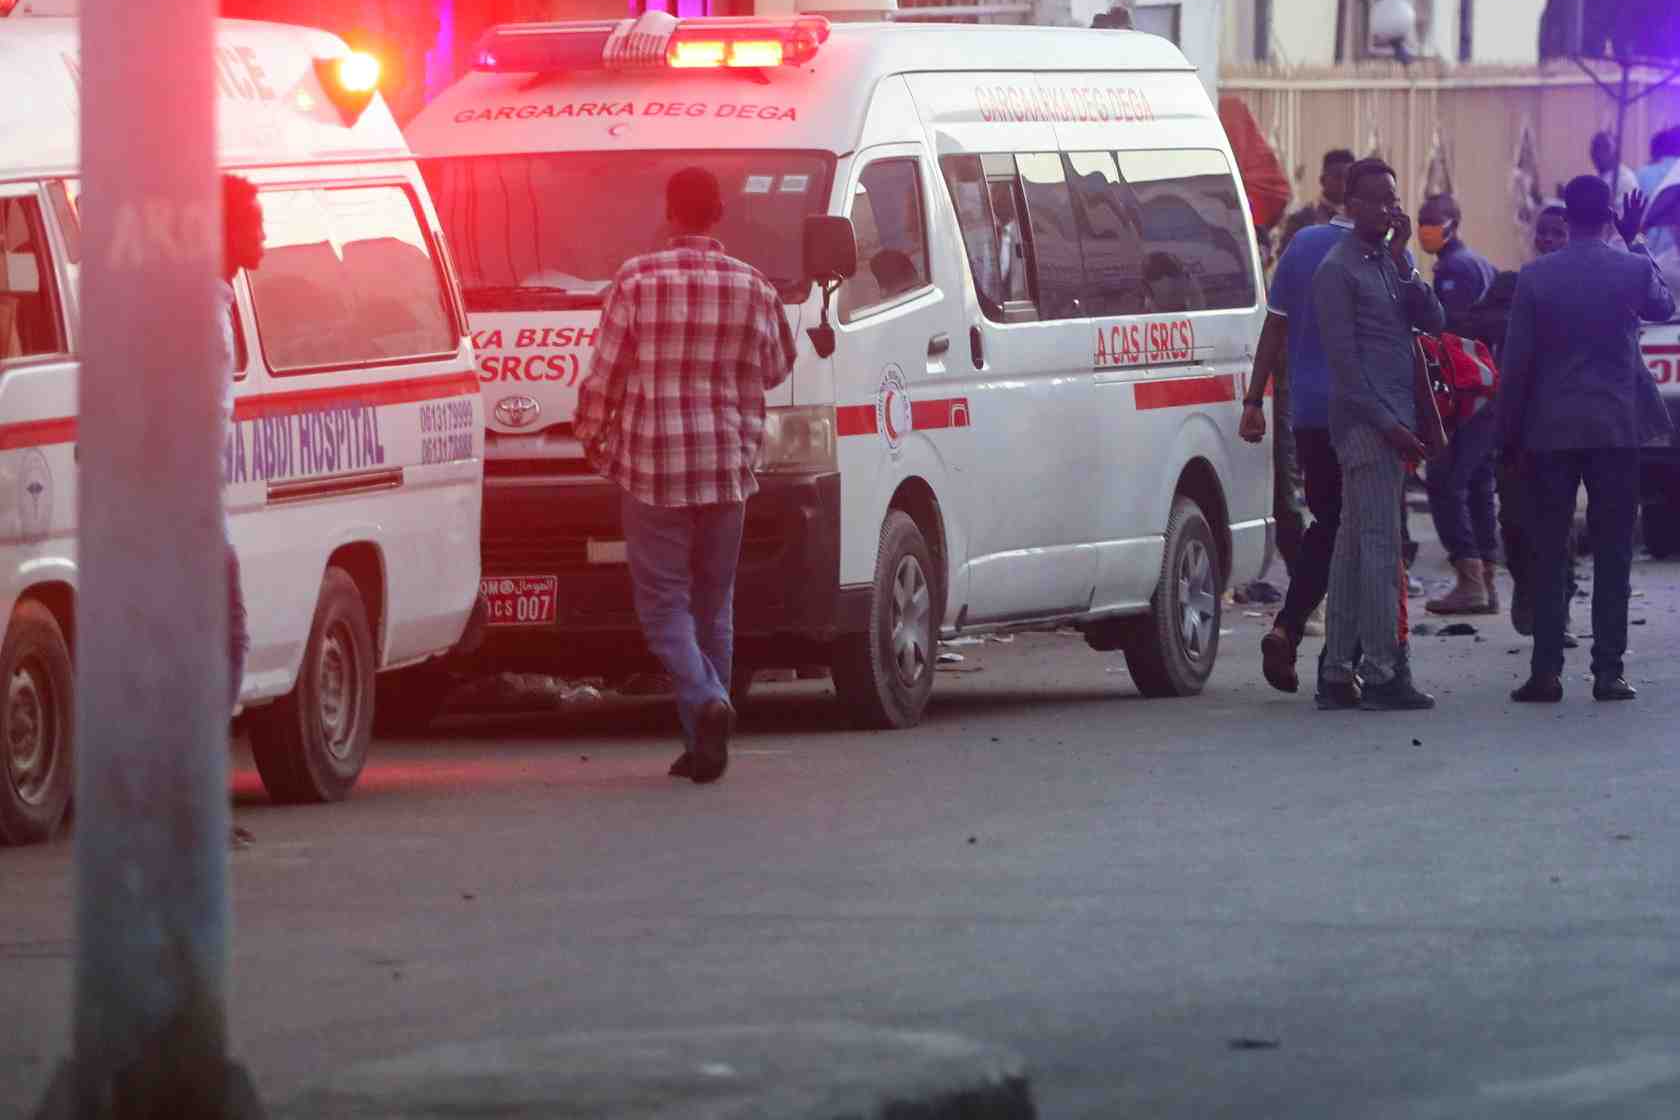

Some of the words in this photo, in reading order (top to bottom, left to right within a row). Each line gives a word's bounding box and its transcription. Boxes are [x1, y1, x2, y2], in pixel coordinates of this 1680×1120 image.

[453, 101, 635, 123] GARGAARKA
[642, 101, 707, 117] DEG
[714, 103, 798, 122] DEGA
[1111, 325, 1140, 364] CAS
[1144, 319, 1194, 365] (SRCS)
[475, 353, 579, 388] SRCS)
[252, 414, 295, 481] ABDI
[299, 405, 385, 475] HOSPITAL
[516, 595, 551, 621] 007
